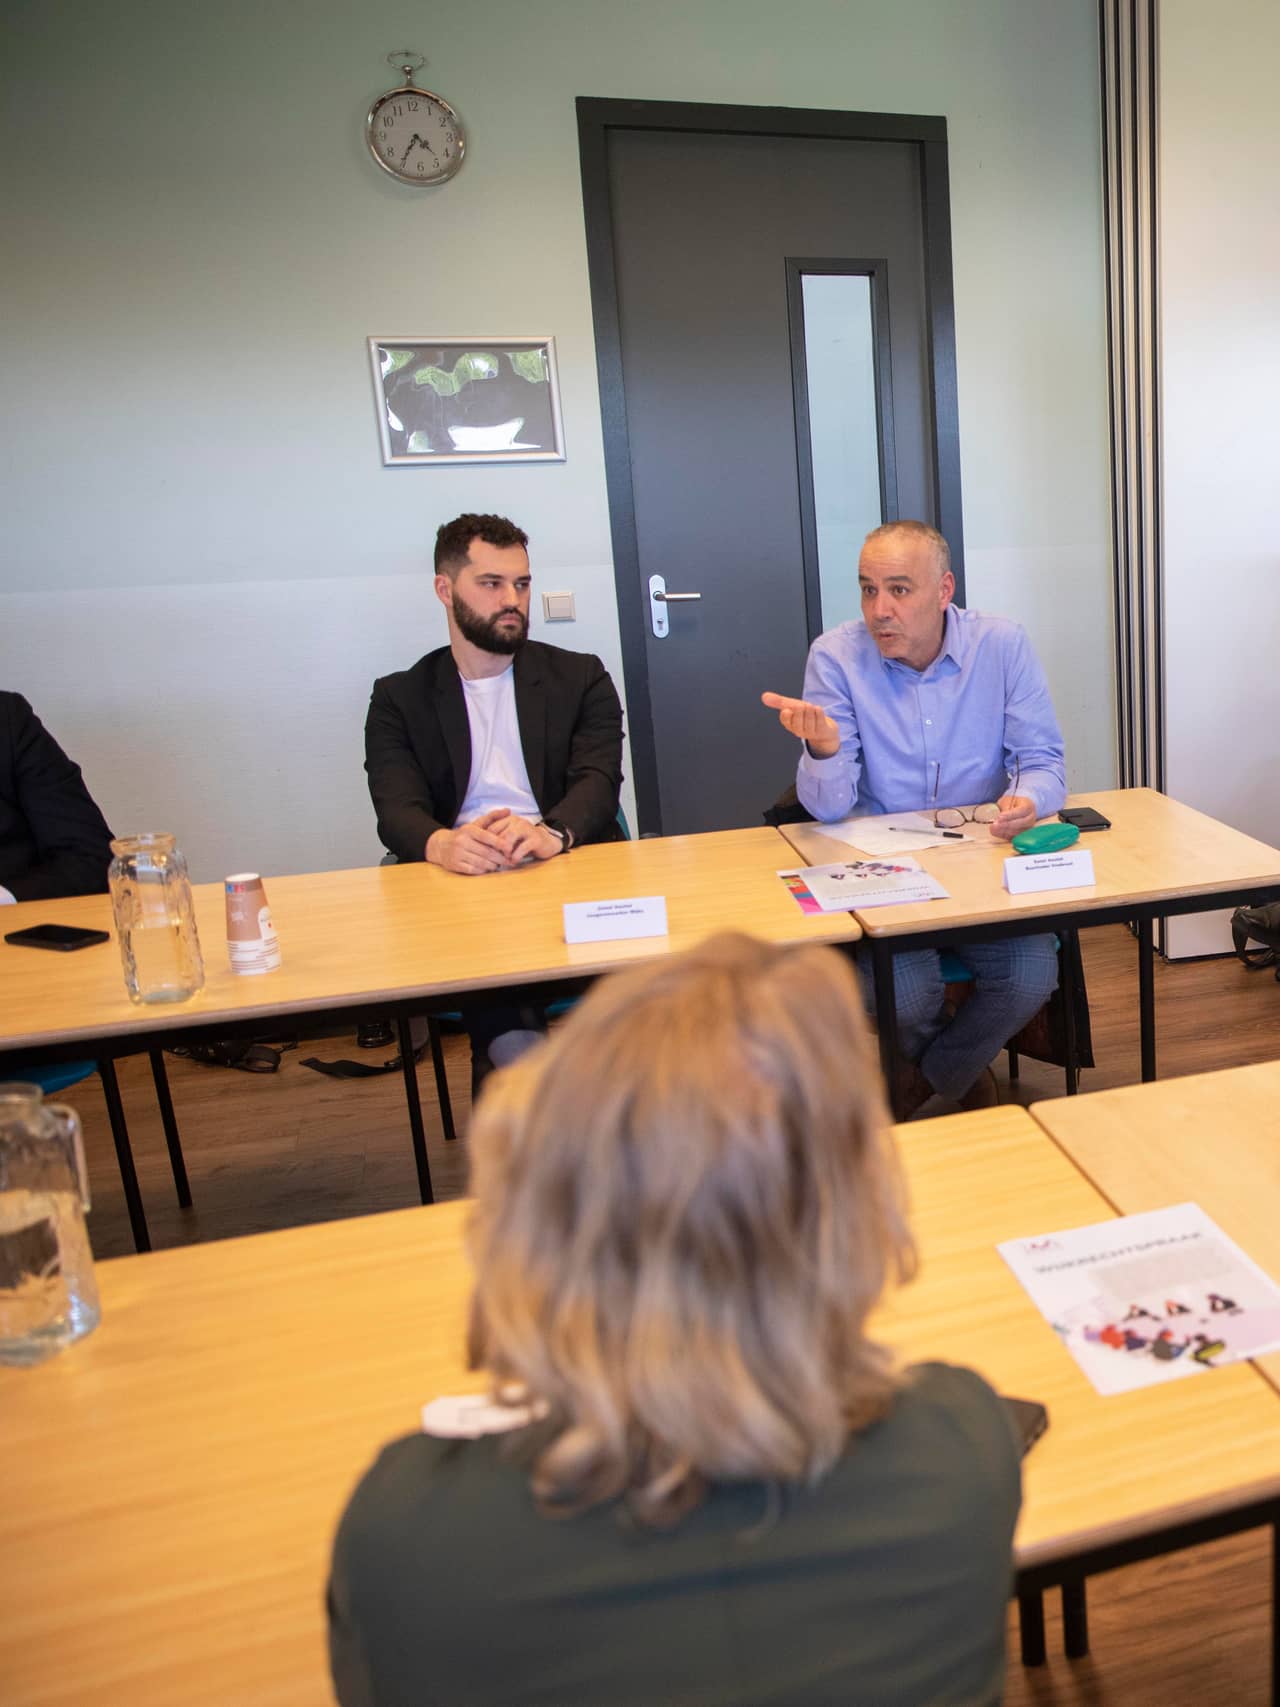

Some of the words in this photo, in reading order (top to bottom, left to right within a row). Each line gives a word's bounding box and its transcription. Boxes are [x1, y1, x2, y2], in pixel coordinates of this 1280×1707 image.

[393, 105, 402, 116] 11
[407, 101, 419, 112] 12
[383, 116, 394, 128] 10
[439, 117, 447, 128] 2
[446, 131, 453, 143] 3
[387, 147, 395, 157] 8
[417, 161, 425, 172] 6
[432, 158, 440, 169] 5
